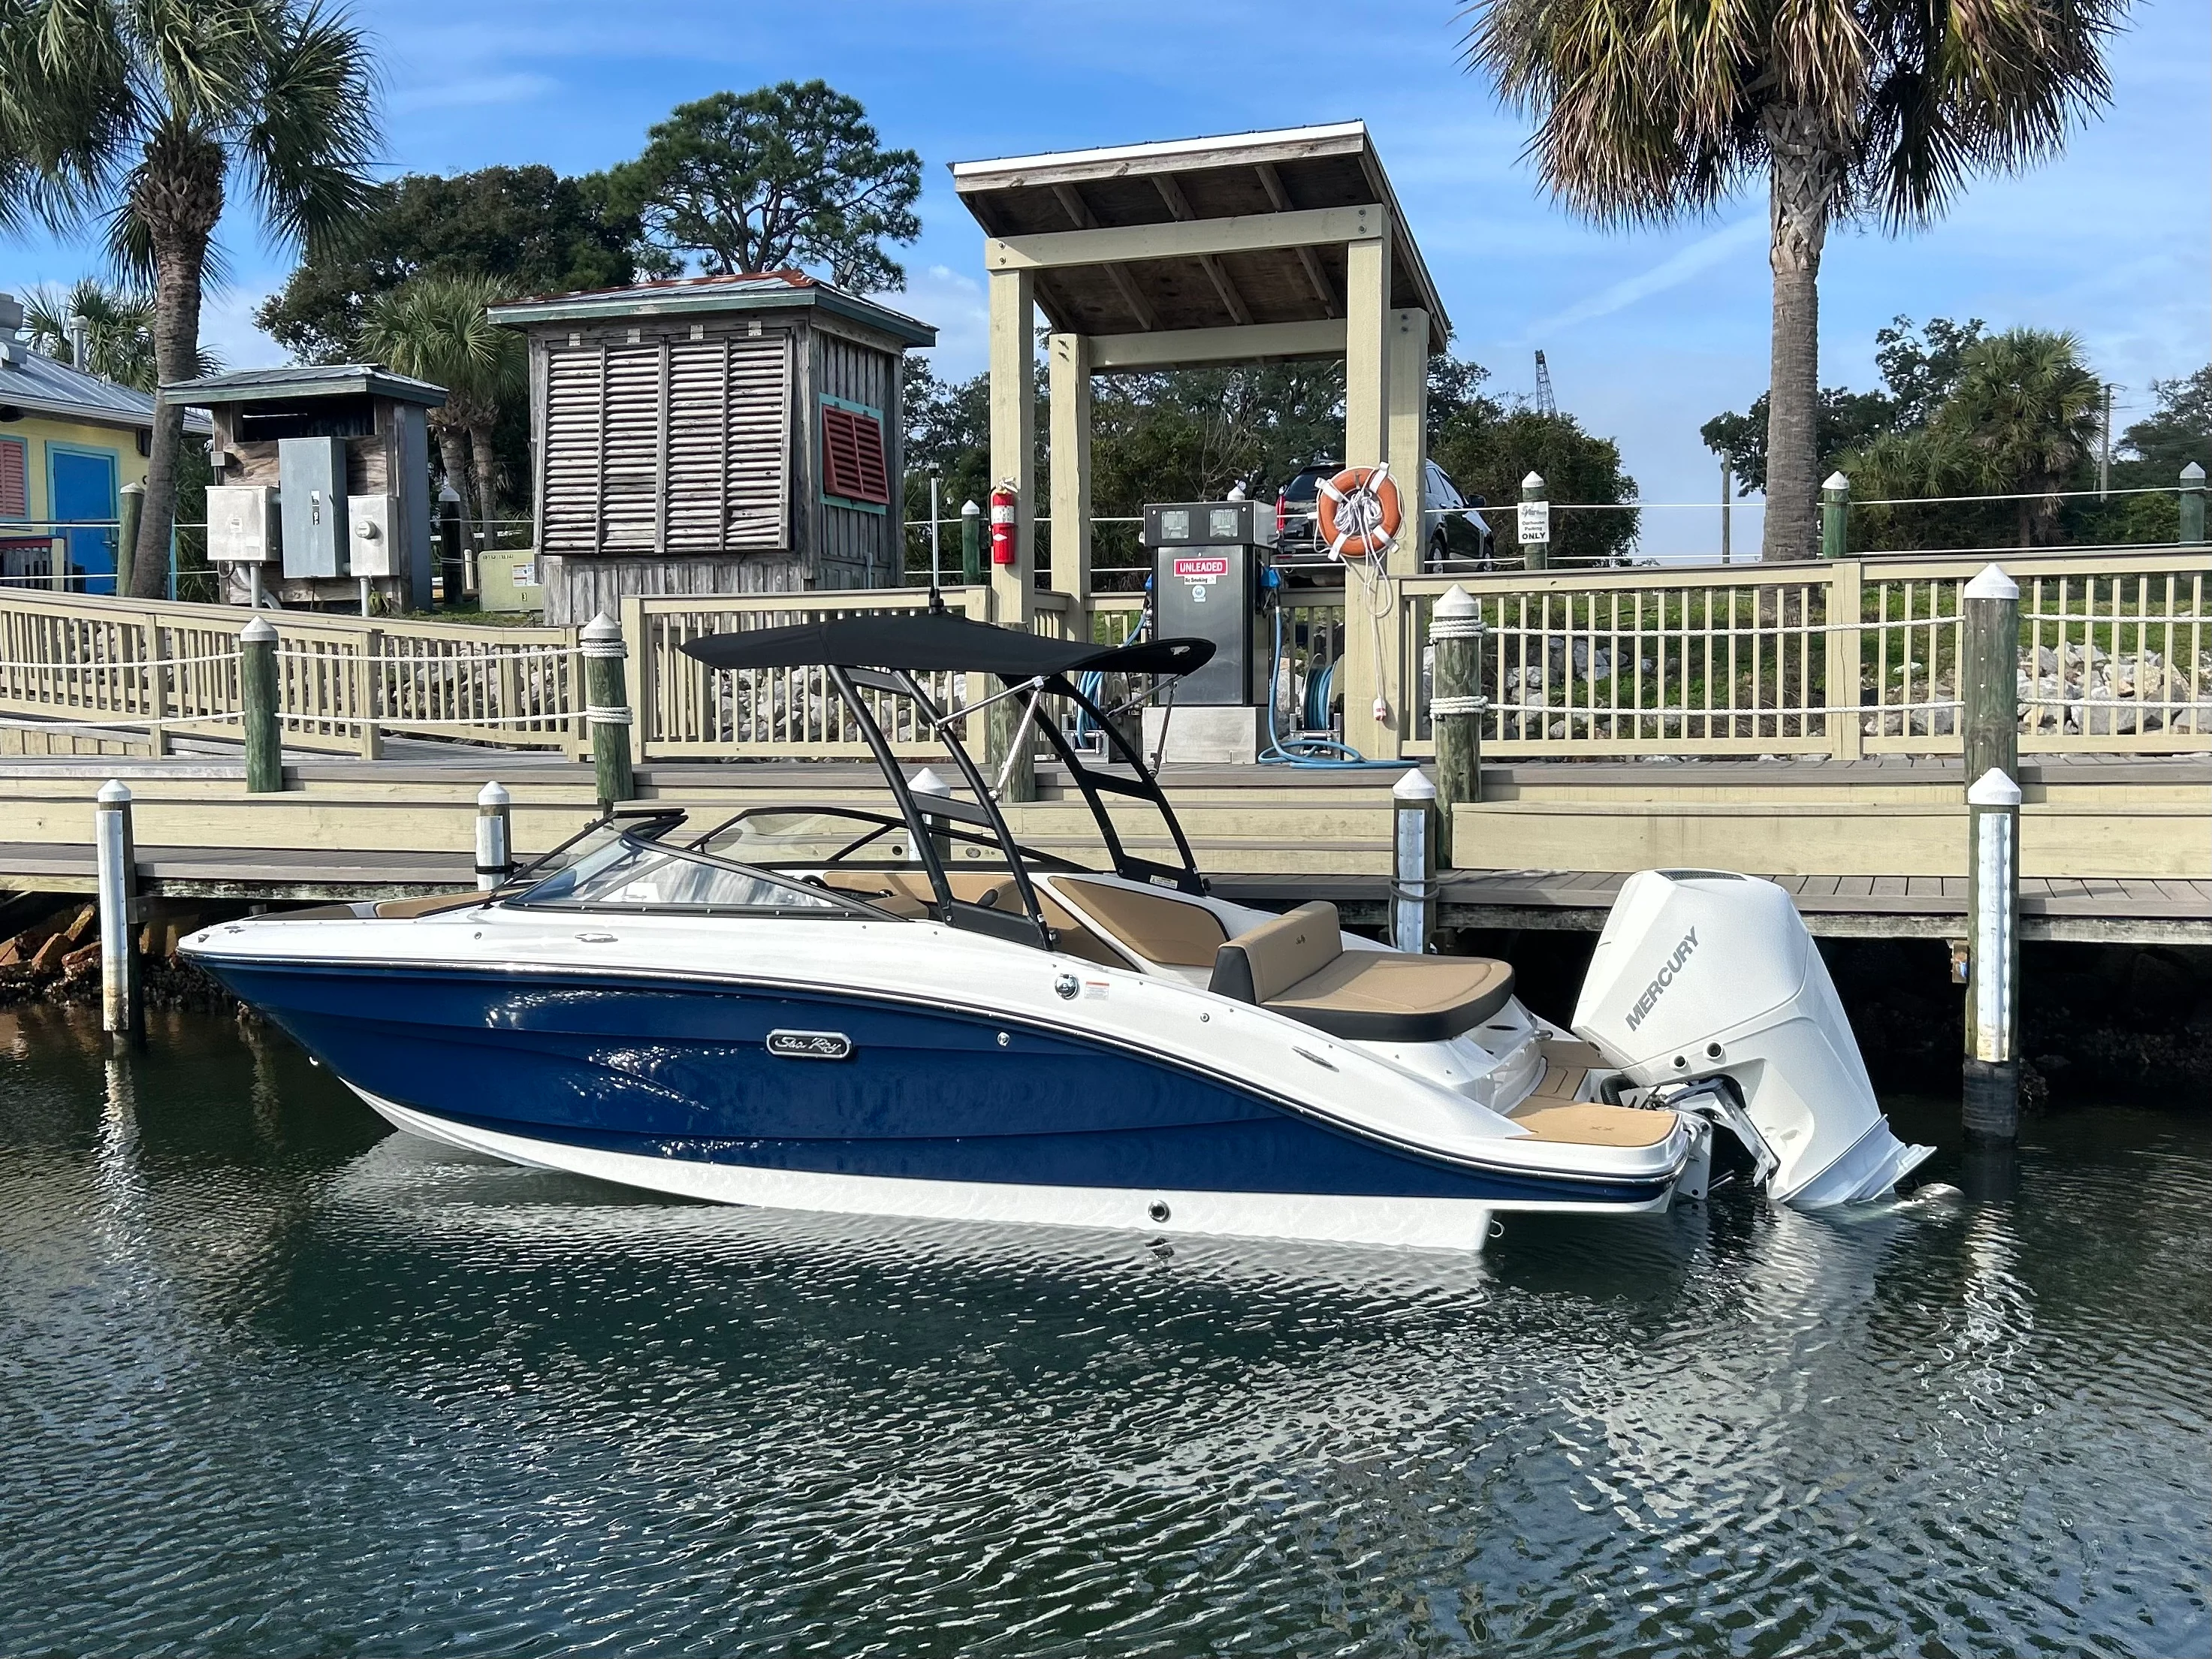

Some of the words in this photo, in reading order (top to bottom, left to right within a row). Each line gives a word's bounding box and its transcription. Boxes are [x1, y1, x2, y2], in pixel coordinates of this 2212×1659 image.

[1522, 532, 1546, 540] ONLY
[1179, 561, 1223, 573] UNLEADED
[1625, 925, 1699, 1032] MERCURY
[774, 1036, 807, 1049] Sea
[808, 1036, 841, 1054] Ray
